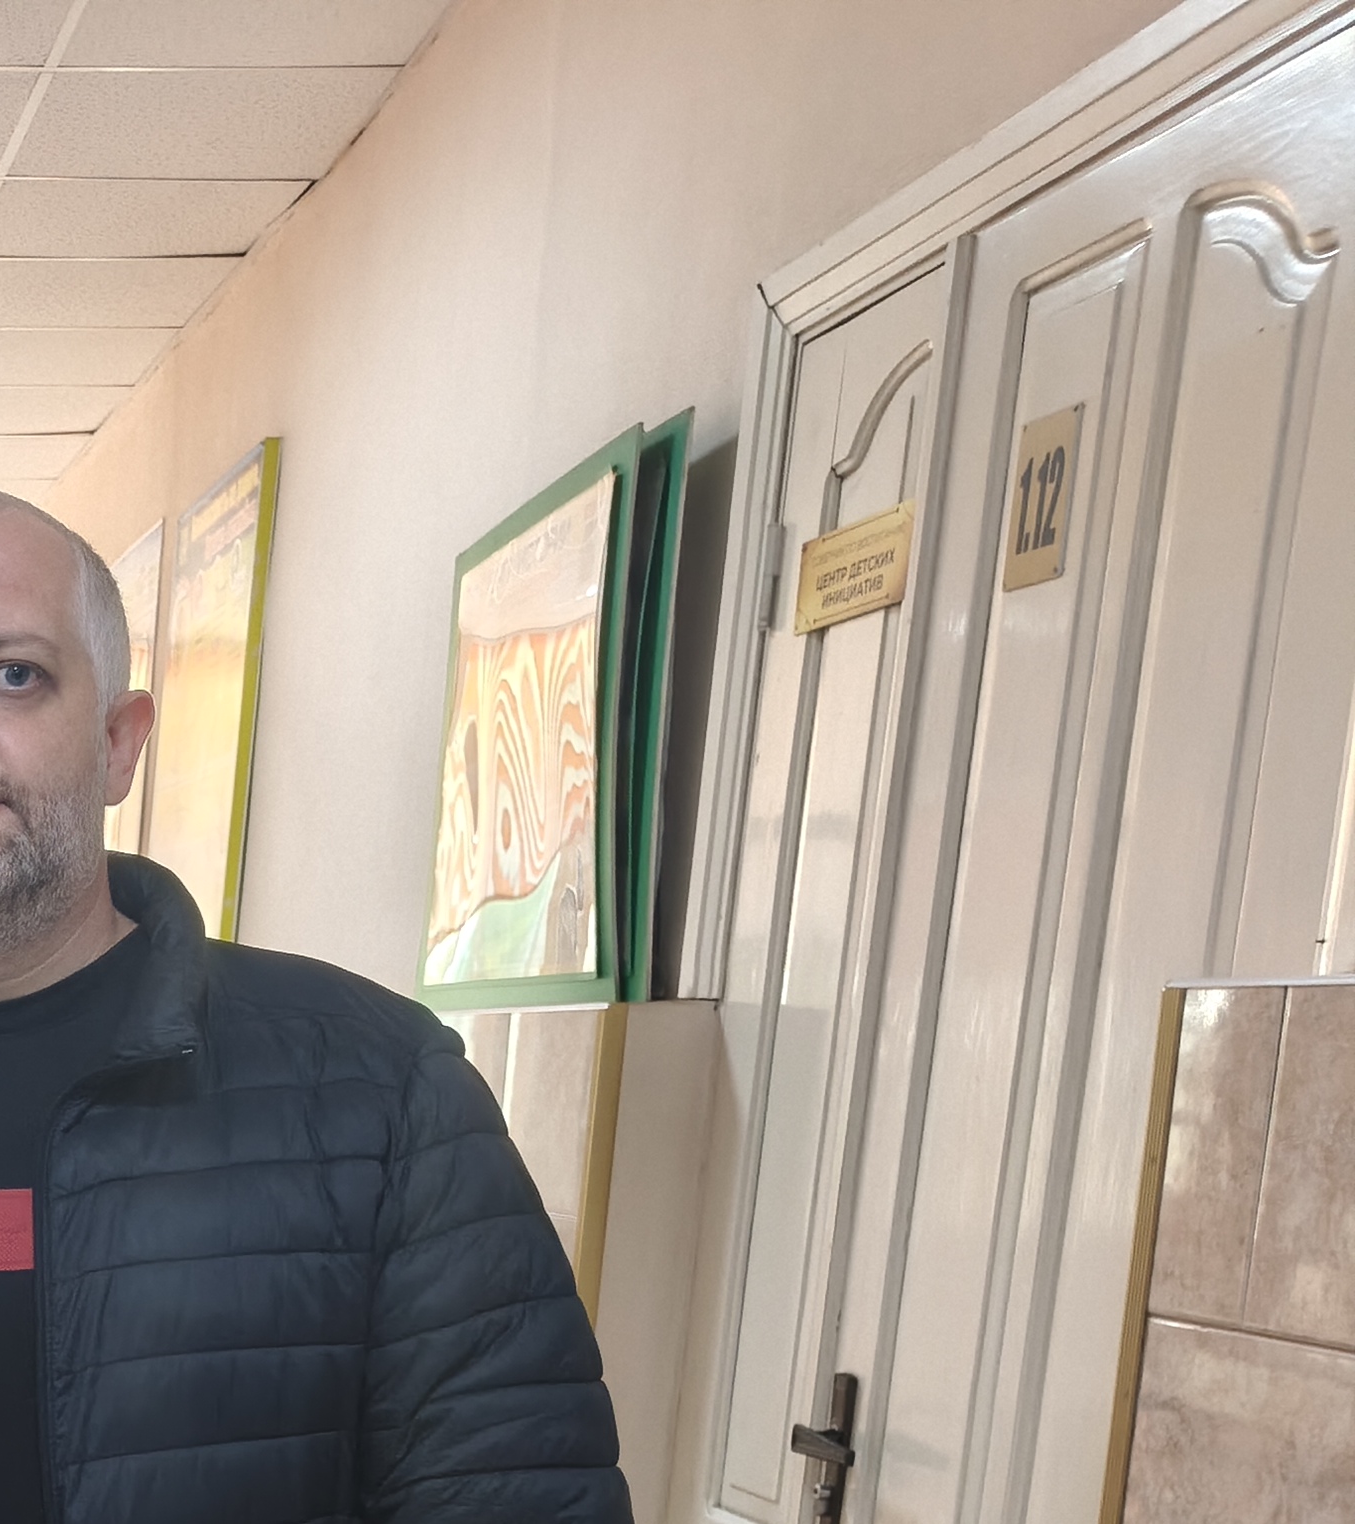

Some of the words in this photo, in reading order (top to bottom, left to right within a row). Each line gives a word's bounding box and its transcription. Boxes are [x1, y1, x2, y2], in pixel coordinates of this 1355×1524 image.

[815, 566, 848, 591] ЦЕНТР
[848, 547, 896, 582] ДЕТСКИХ
[821, 573, 884, 609] ИНИЦИАТИВ
